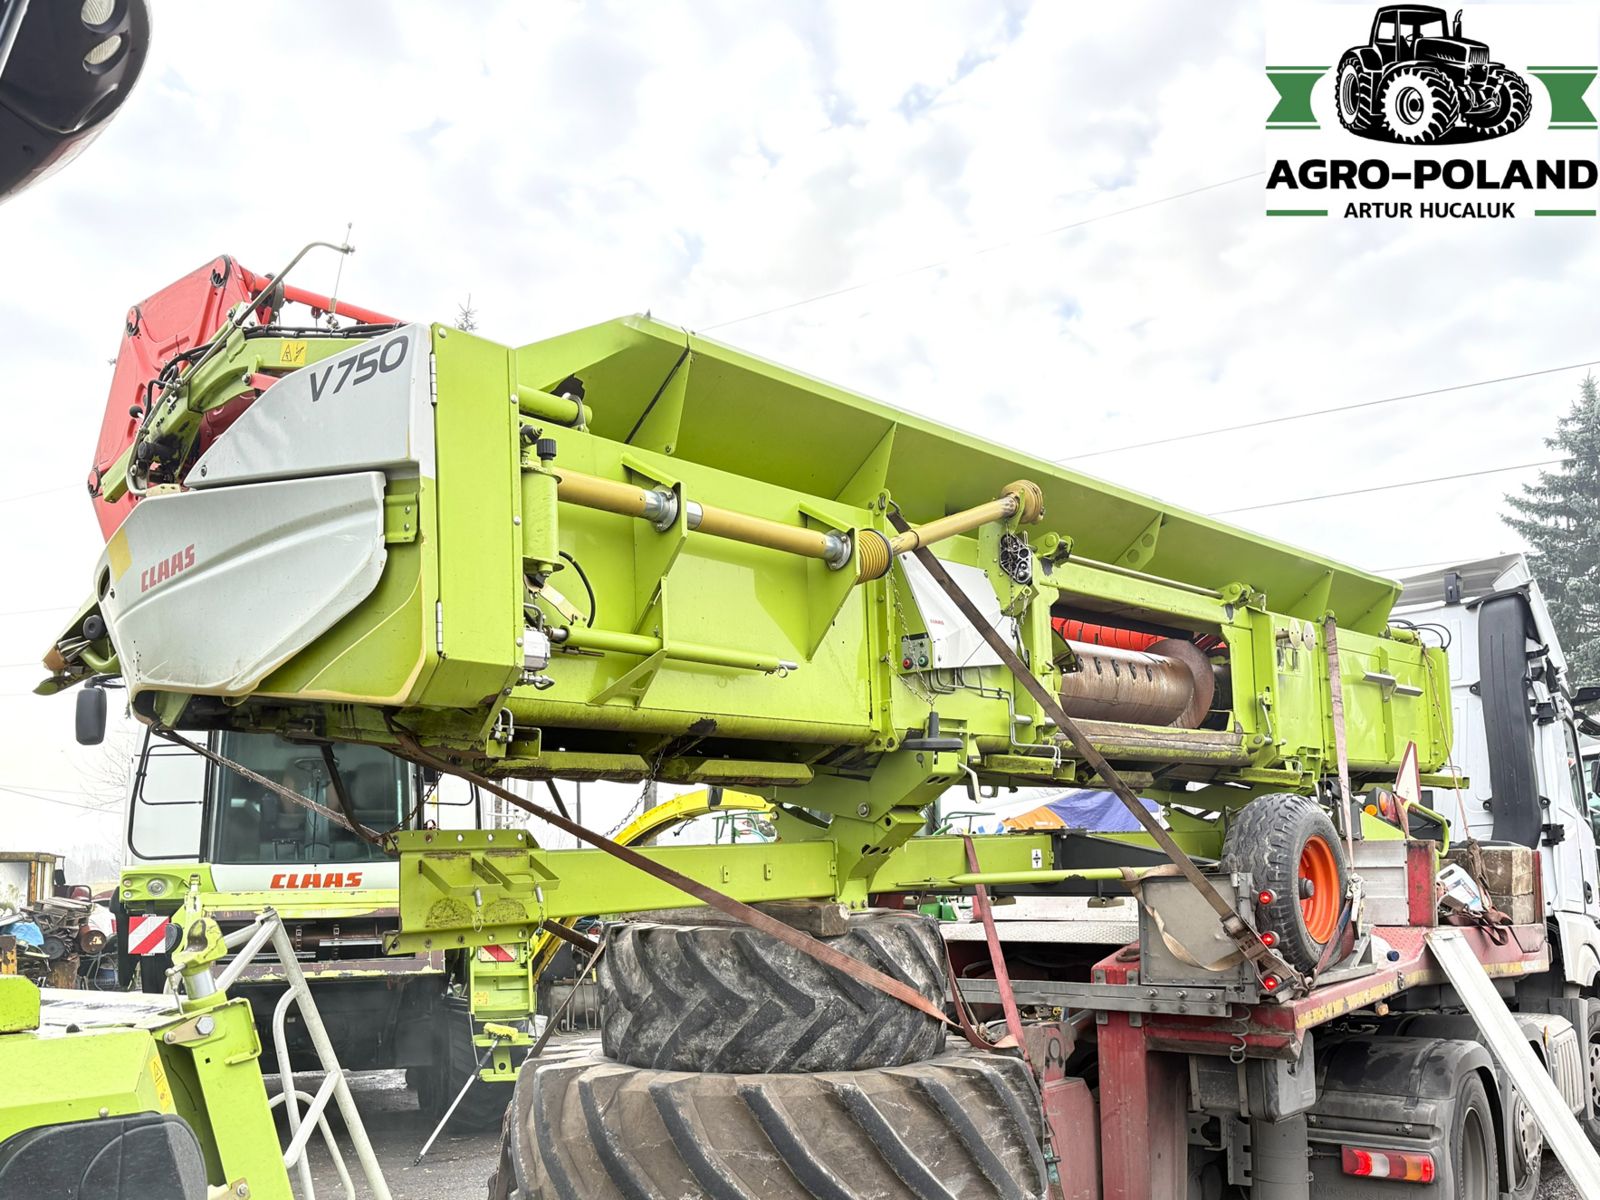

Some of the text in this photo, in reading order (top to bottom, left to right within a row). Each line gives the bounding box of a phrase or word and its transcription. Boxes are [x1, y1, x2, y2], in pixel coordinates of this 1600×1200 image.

[310, 335, 409, 402] V750
[141, 543, 195, 593] CLAAS
[270, 872, 363, 889] CLAAS
